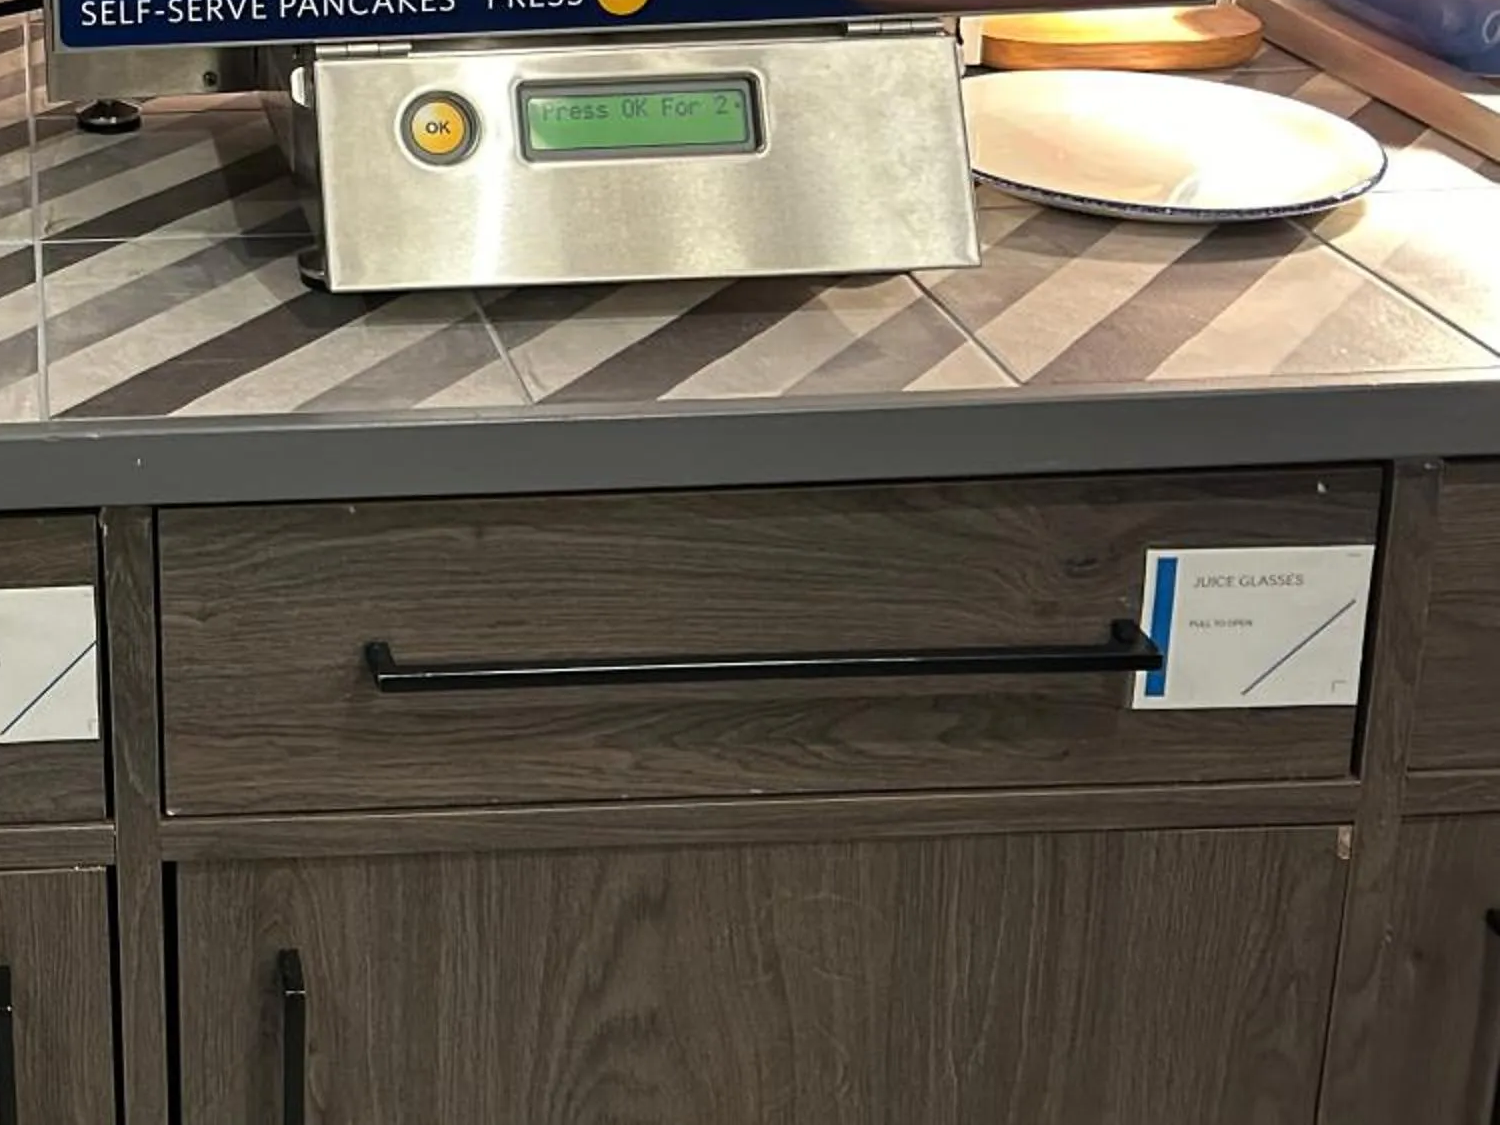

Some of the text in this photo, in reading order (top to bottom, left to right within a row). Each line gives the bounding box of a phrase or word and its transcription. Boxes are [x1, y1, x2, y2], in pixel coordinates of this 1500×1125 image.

[541, 103, 610, 122] Press
[621, 99, 649, 119] OK
[661, 97, 700, 117] For
[425, 120, 451, 135] OK
[1193, 572, 1304, 589] JUICE GLASSES
